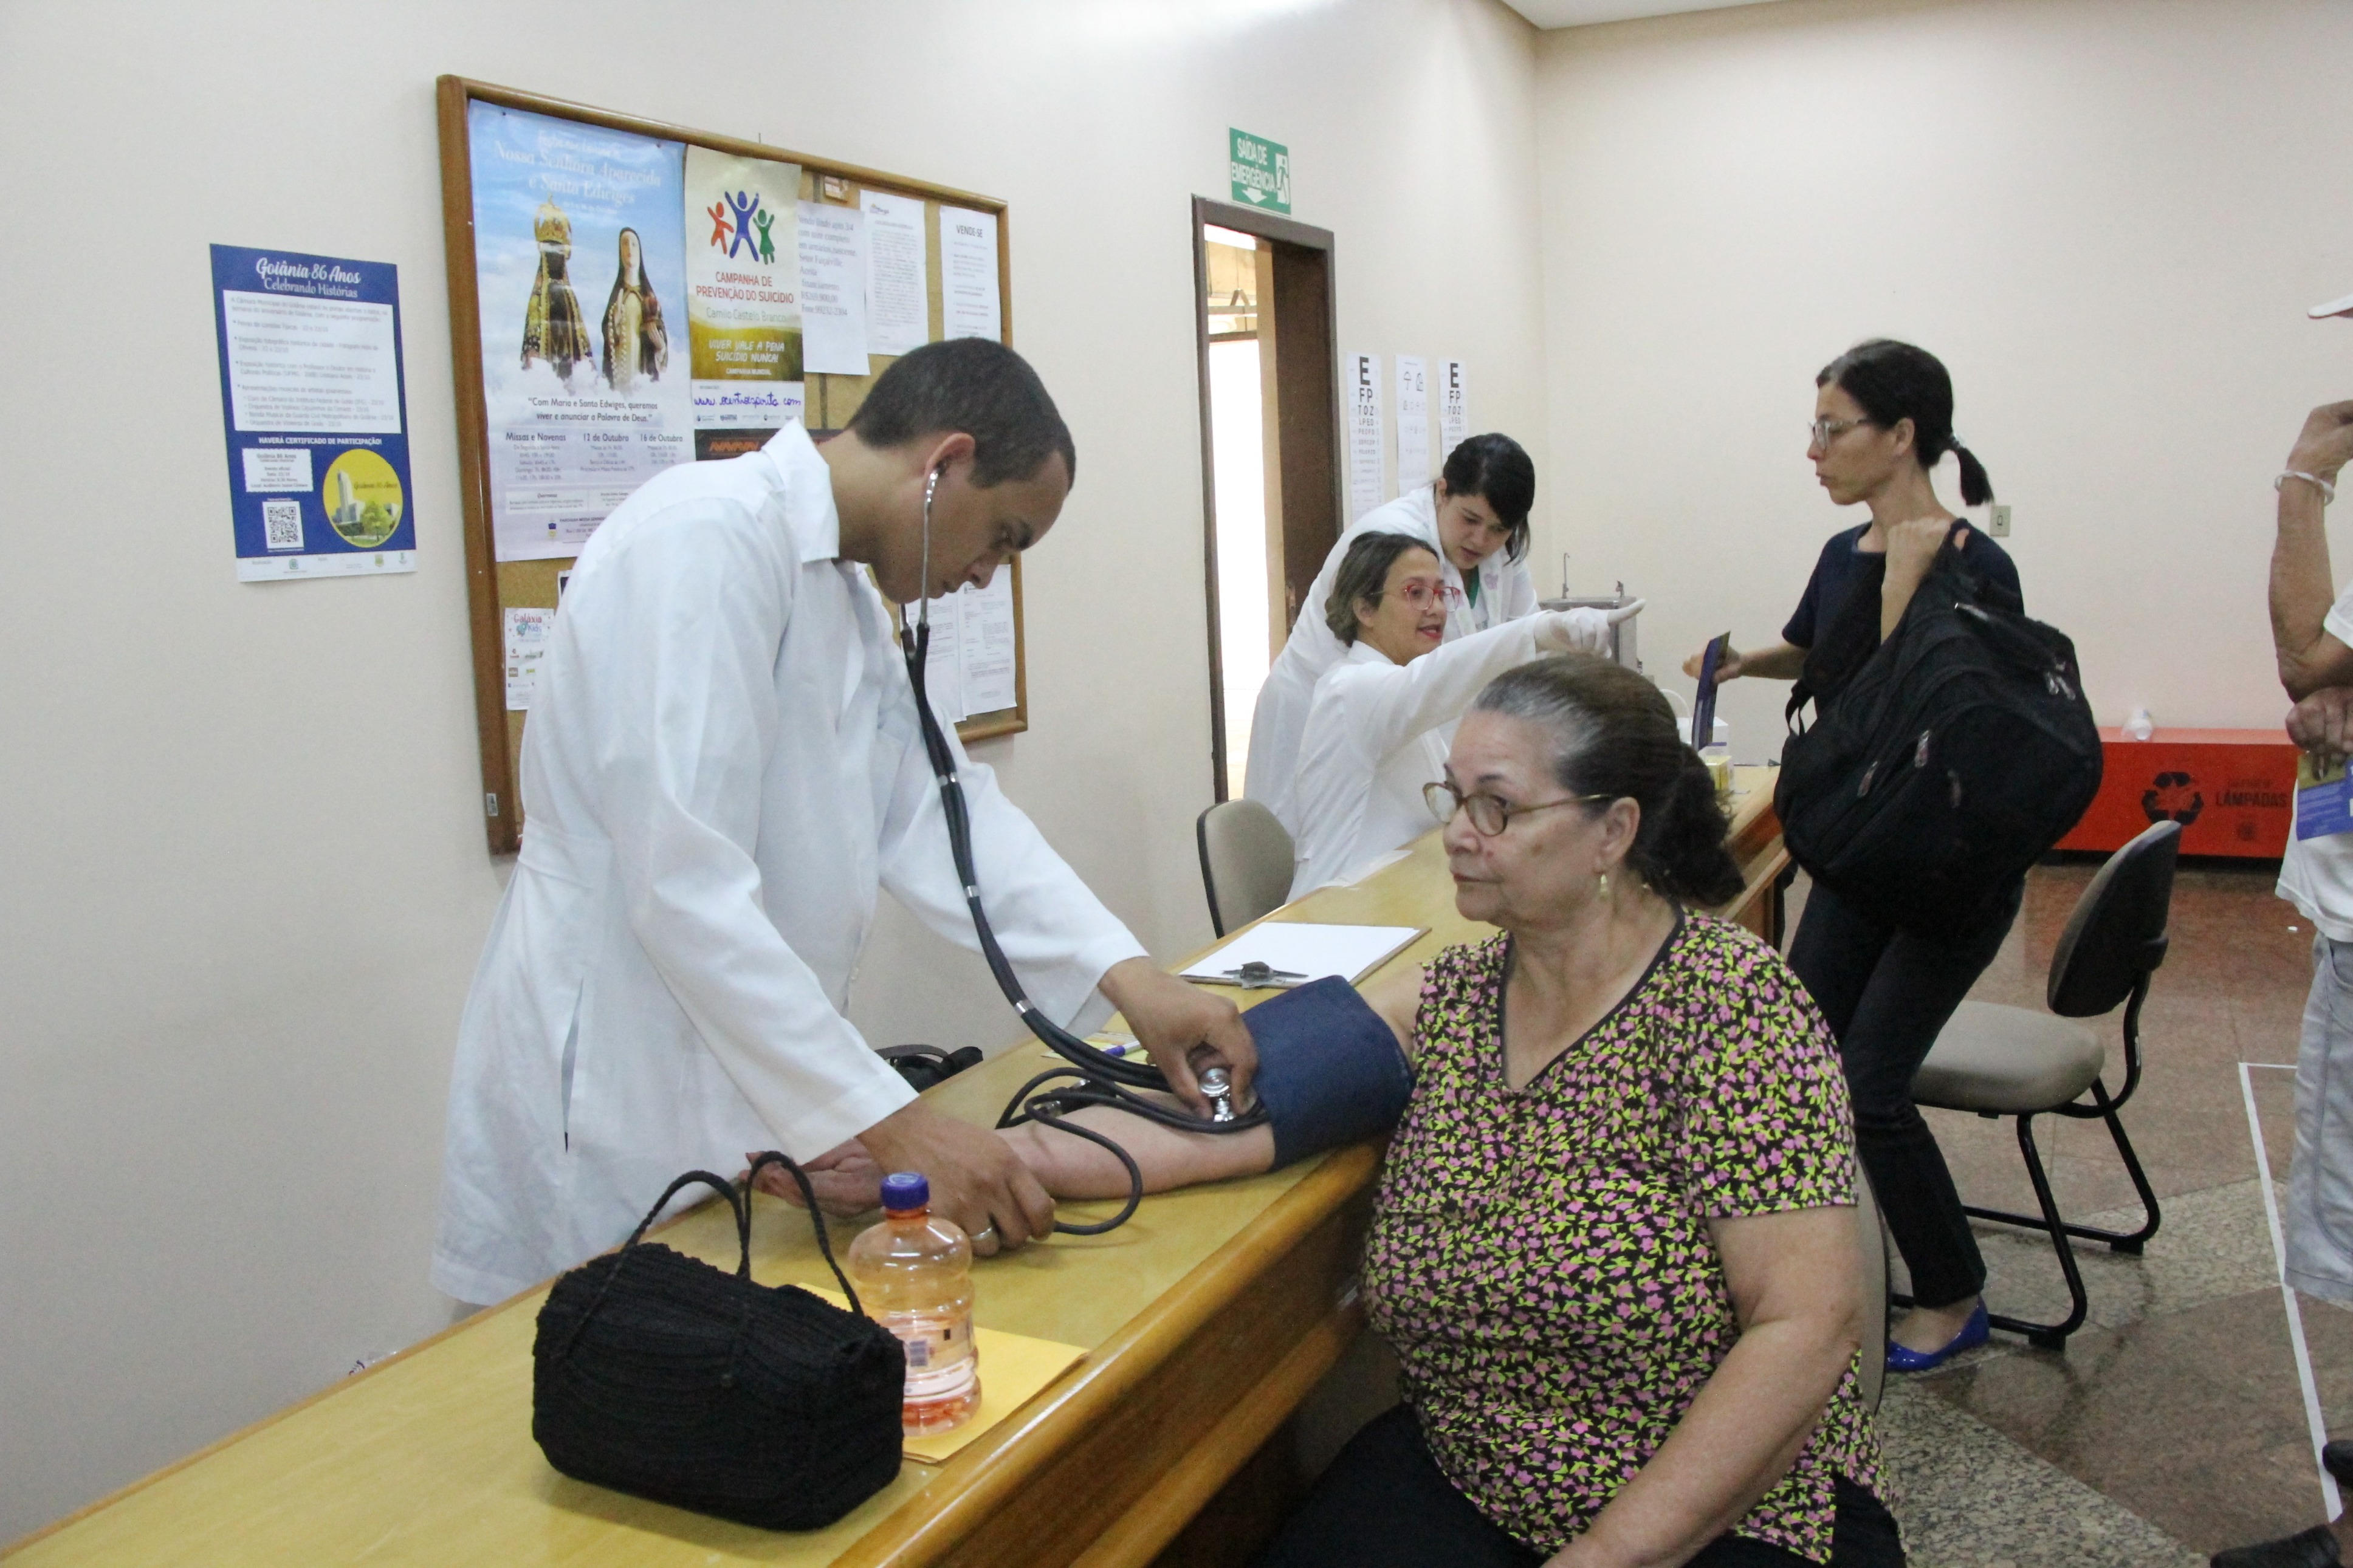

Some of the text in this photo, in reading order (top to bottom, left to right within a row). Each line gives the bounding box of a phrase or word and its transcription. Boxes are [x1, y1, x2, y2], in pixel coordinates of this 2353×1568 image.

[1237, 135, 1267, 165] SAÍDA DE
[1231, 161, 1276, 193] EMERGÊNCIA
[956, 224, 983, 238] VENDE-SE
[256, 257, 362, 284] Goiânia 86 Anos
[716, 272, 772, 287] CAMPANHA DE
[264, 277, 358, 298] Celebrando Histórias
[696, 286, 794, 304] PREVENÇÃO DO SUICÍDIO
[706, 307, 786, 323] Camilo Castelo Branco
[709, 340, 785, 352] VIVER VALE A PENA
[716, 351, 778, 363] SUICÍDIO NUNCA!
[1359, 356, 1370, 386] E
[1450, 363, 1459, 388] E
[551, 398, 571, 407] Maria
[600, 400, 627, 411] Edwiges,
[628, 402, 658, 411] queremos
[597, 413, 620, 422] Palavra
[506, 432, 529, 441] Missas
[537, 433, 566, 441] Novenas
[514, 612, 542, 623] Galáxia
[527, 624, 541, 632] Kids
